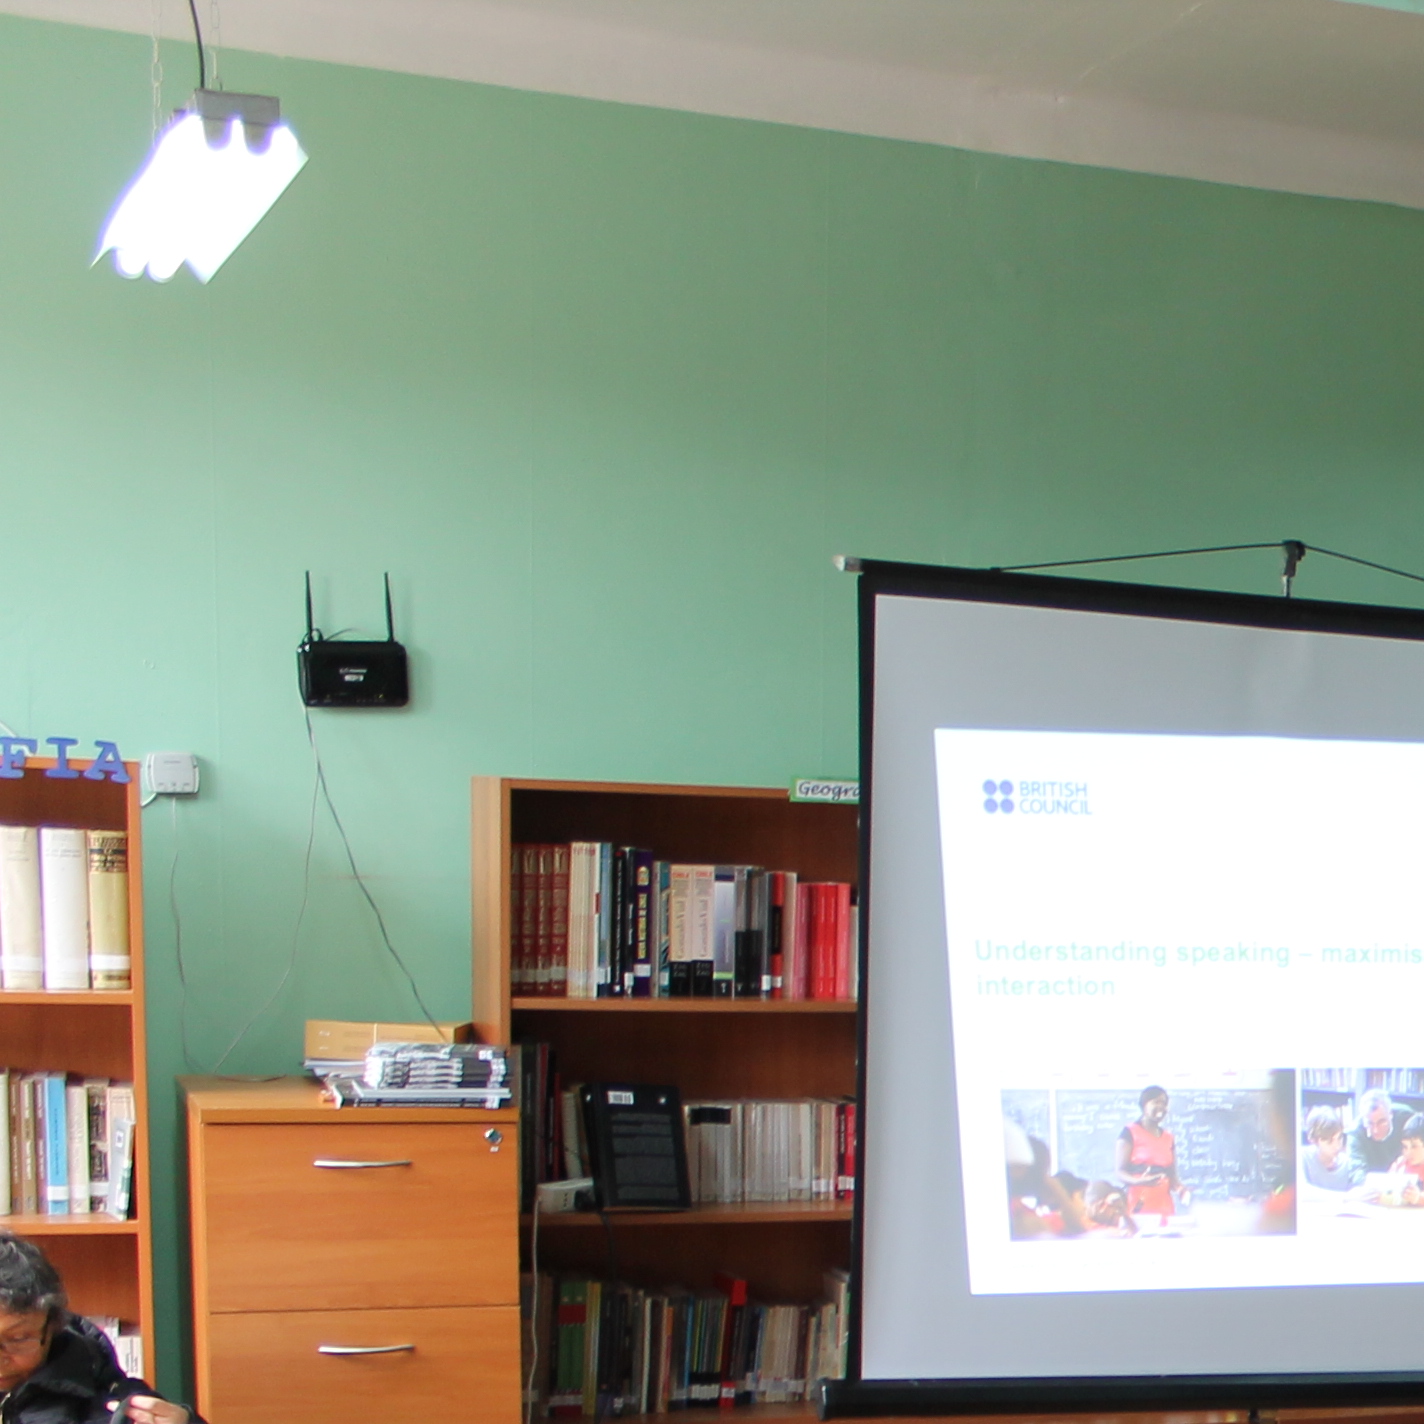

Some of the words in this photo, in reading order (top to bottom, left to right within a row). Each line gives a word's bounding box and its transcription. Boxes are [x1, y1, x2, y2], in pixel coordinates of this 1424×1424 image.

[1018, 781, 1088, 798] BRITISH
[1018, 798, 1093, 815] COUNCIL
[974, 939, 1168, 968] Understanding
[1176, 941, 1290, 968] speaking
[976, 974, 1116, 997] interaction
